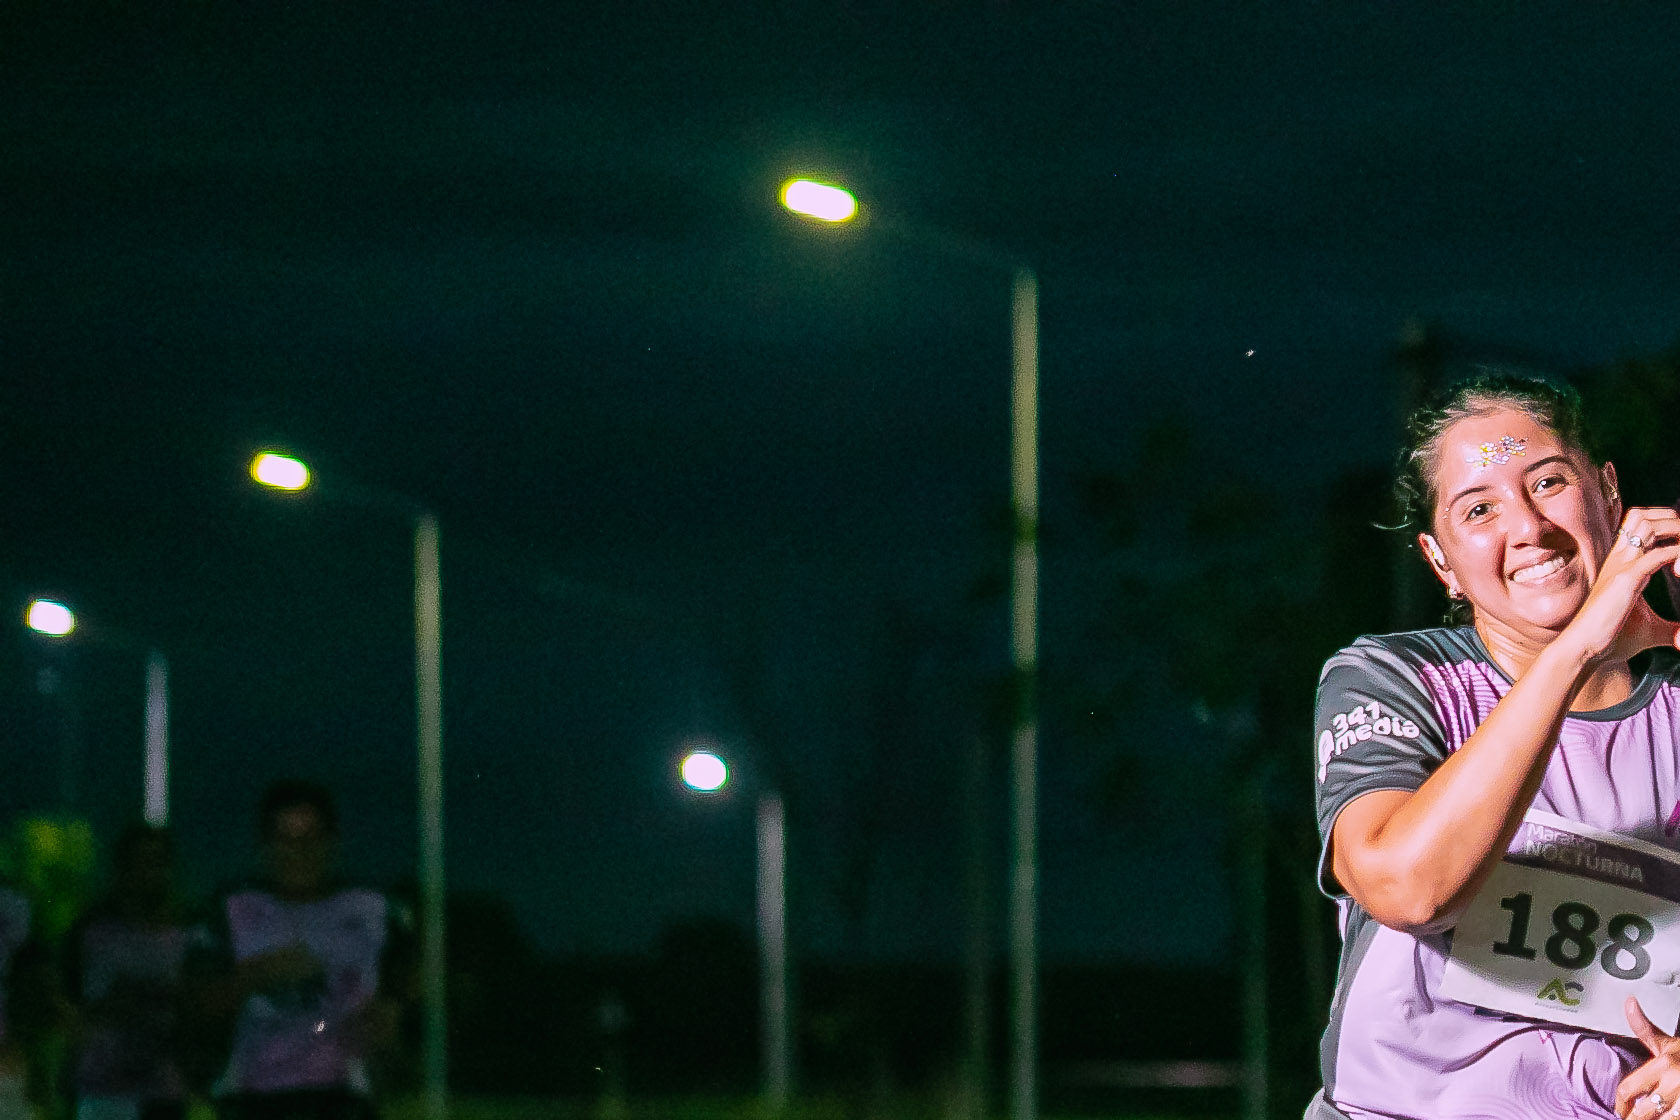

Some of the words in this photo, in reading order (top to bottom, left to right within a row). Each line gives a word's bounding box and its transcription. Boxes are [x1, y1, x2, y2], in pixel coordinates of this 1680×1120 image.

[1333, 701, 1380, 738] 341
[1335, 717, 1420, 756] media
[1492, 891, 1655, 981] 188
